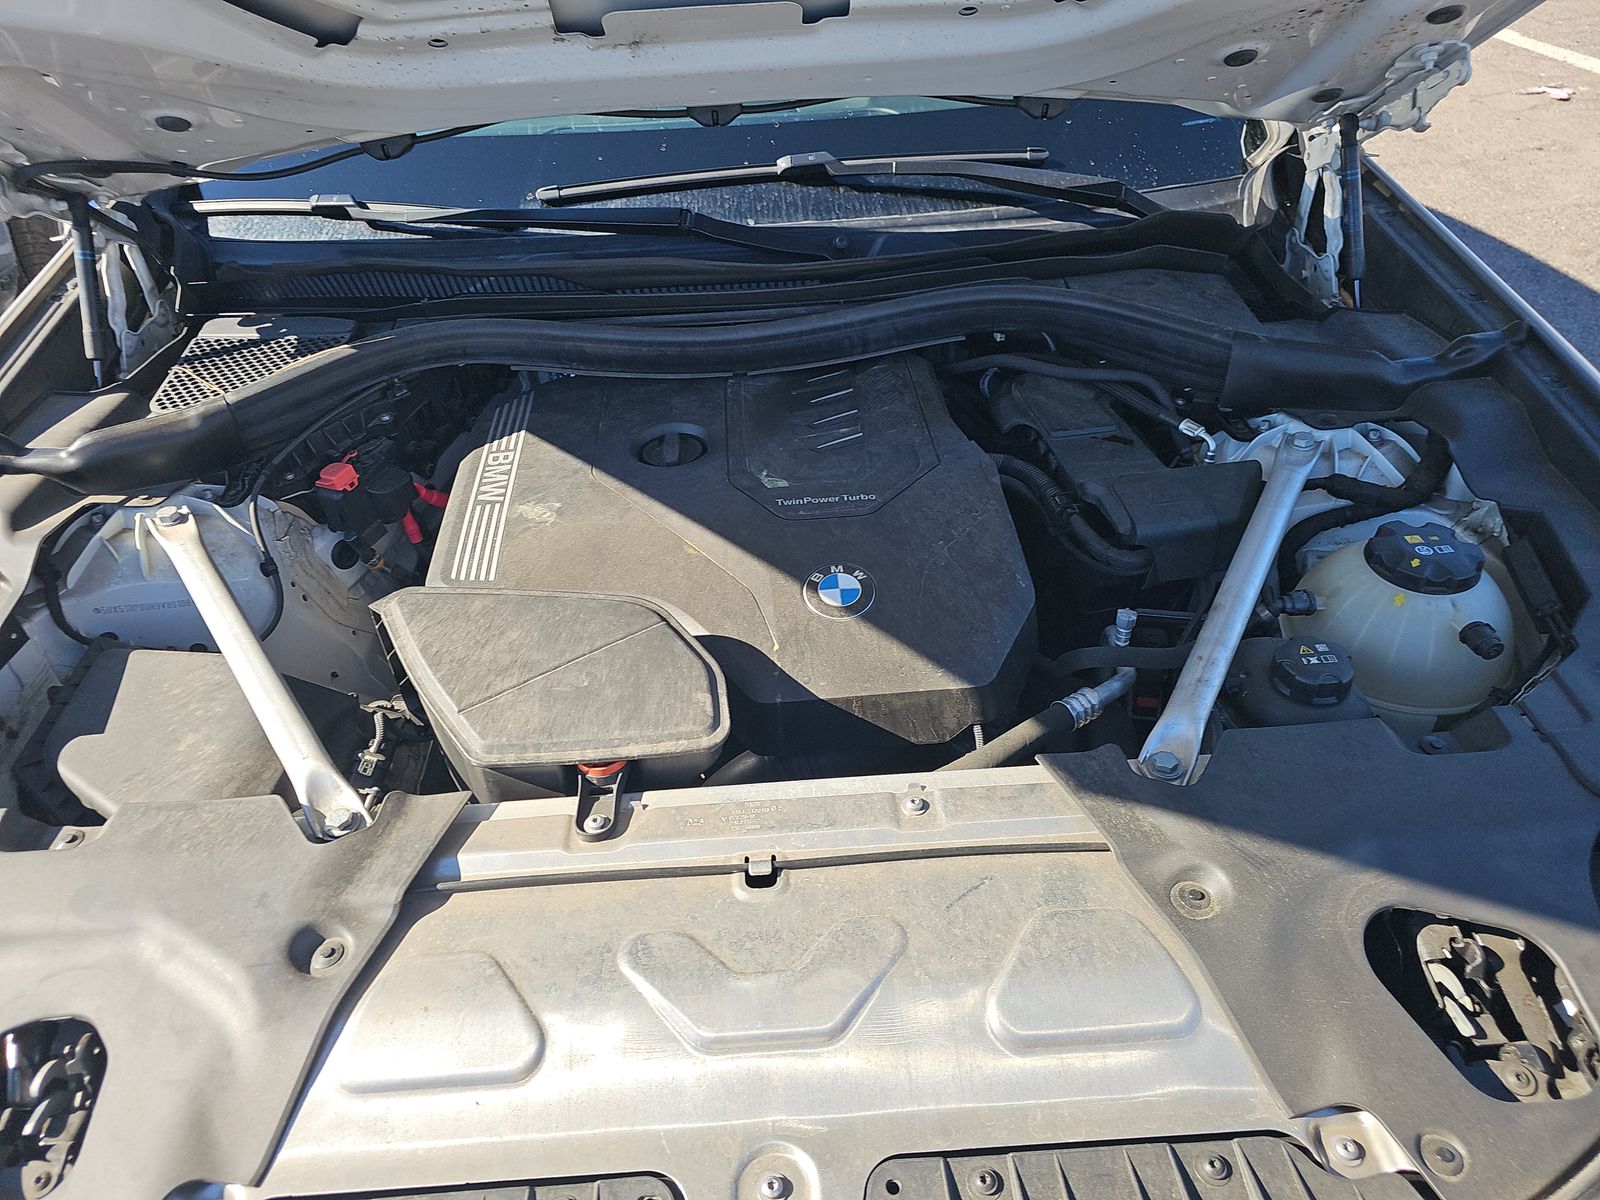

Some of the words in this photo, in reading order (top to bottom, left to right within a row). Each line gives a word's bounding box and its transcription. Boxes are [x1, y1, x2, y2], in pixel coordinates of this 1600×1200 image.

[476, 451, 515, 501] BMW
[775, 496, 841, 507] TwinPower
[842, 493, 876, 502] Turbo
[810, 565, 868, 583] BMW
